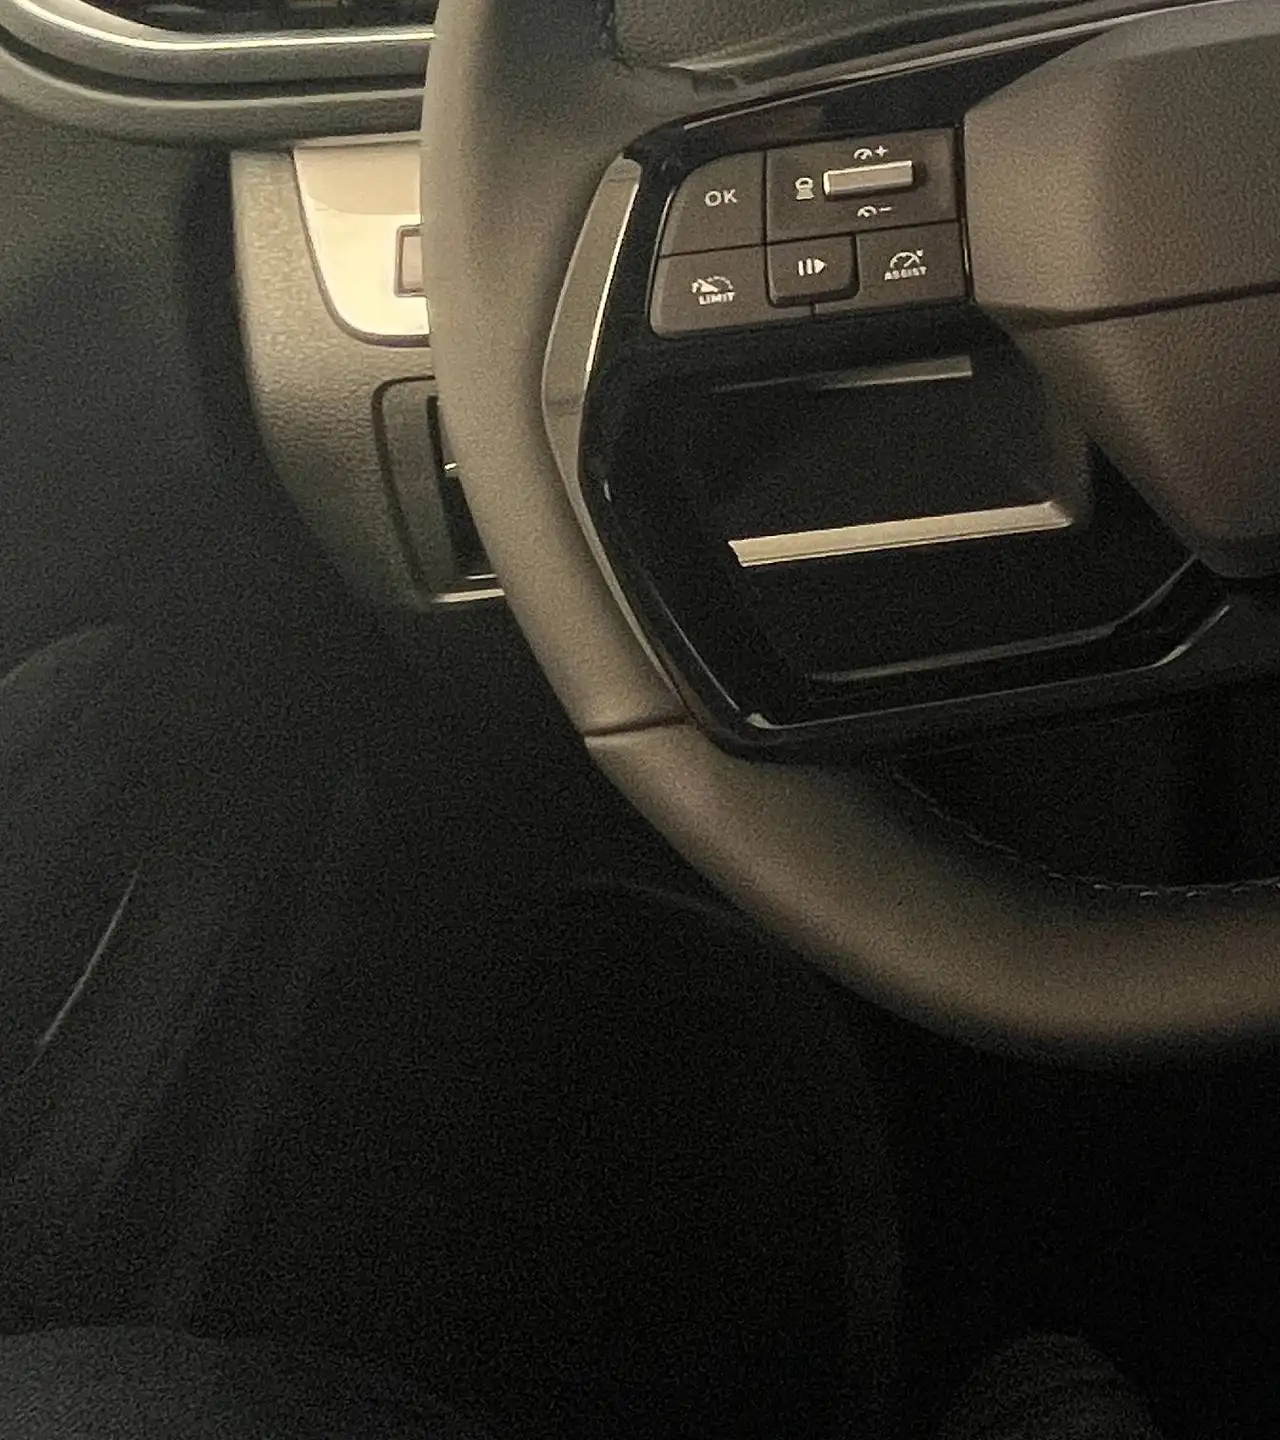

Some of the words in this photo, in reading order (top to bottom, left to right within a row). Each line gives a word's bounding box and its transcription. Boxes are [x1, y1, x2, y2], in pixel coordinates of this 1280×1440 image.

[705, 189, 737, 207] OK
[884, 266, 927, 281] ASSIST
[698, 291, 735, 305] LIMIT
